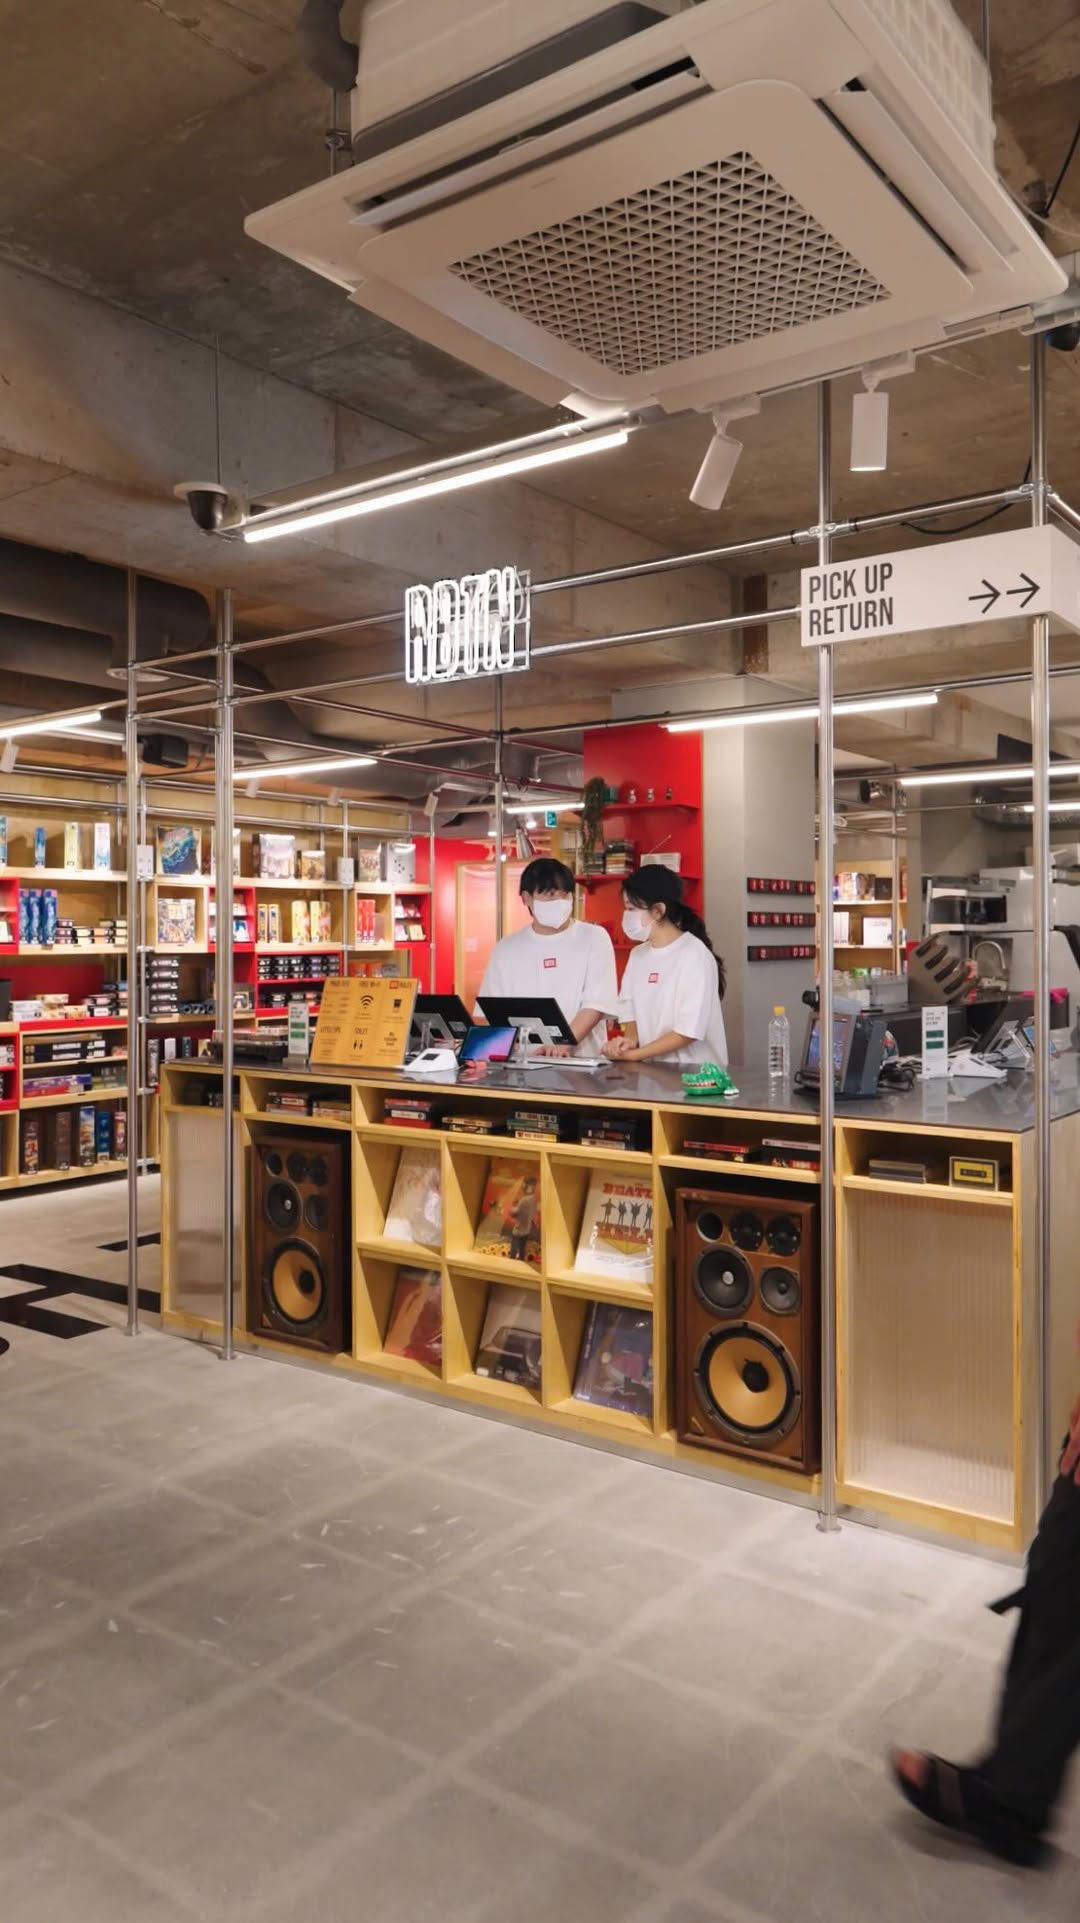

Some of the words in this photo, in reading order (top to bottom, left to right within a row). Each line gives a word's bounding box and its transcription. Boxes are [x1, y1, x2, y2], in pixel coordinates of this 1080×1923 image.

[808, 568, 857, 604] PICK
[864, 562, 893, 594] UP
[808, 597, 894, 637] RETURN
